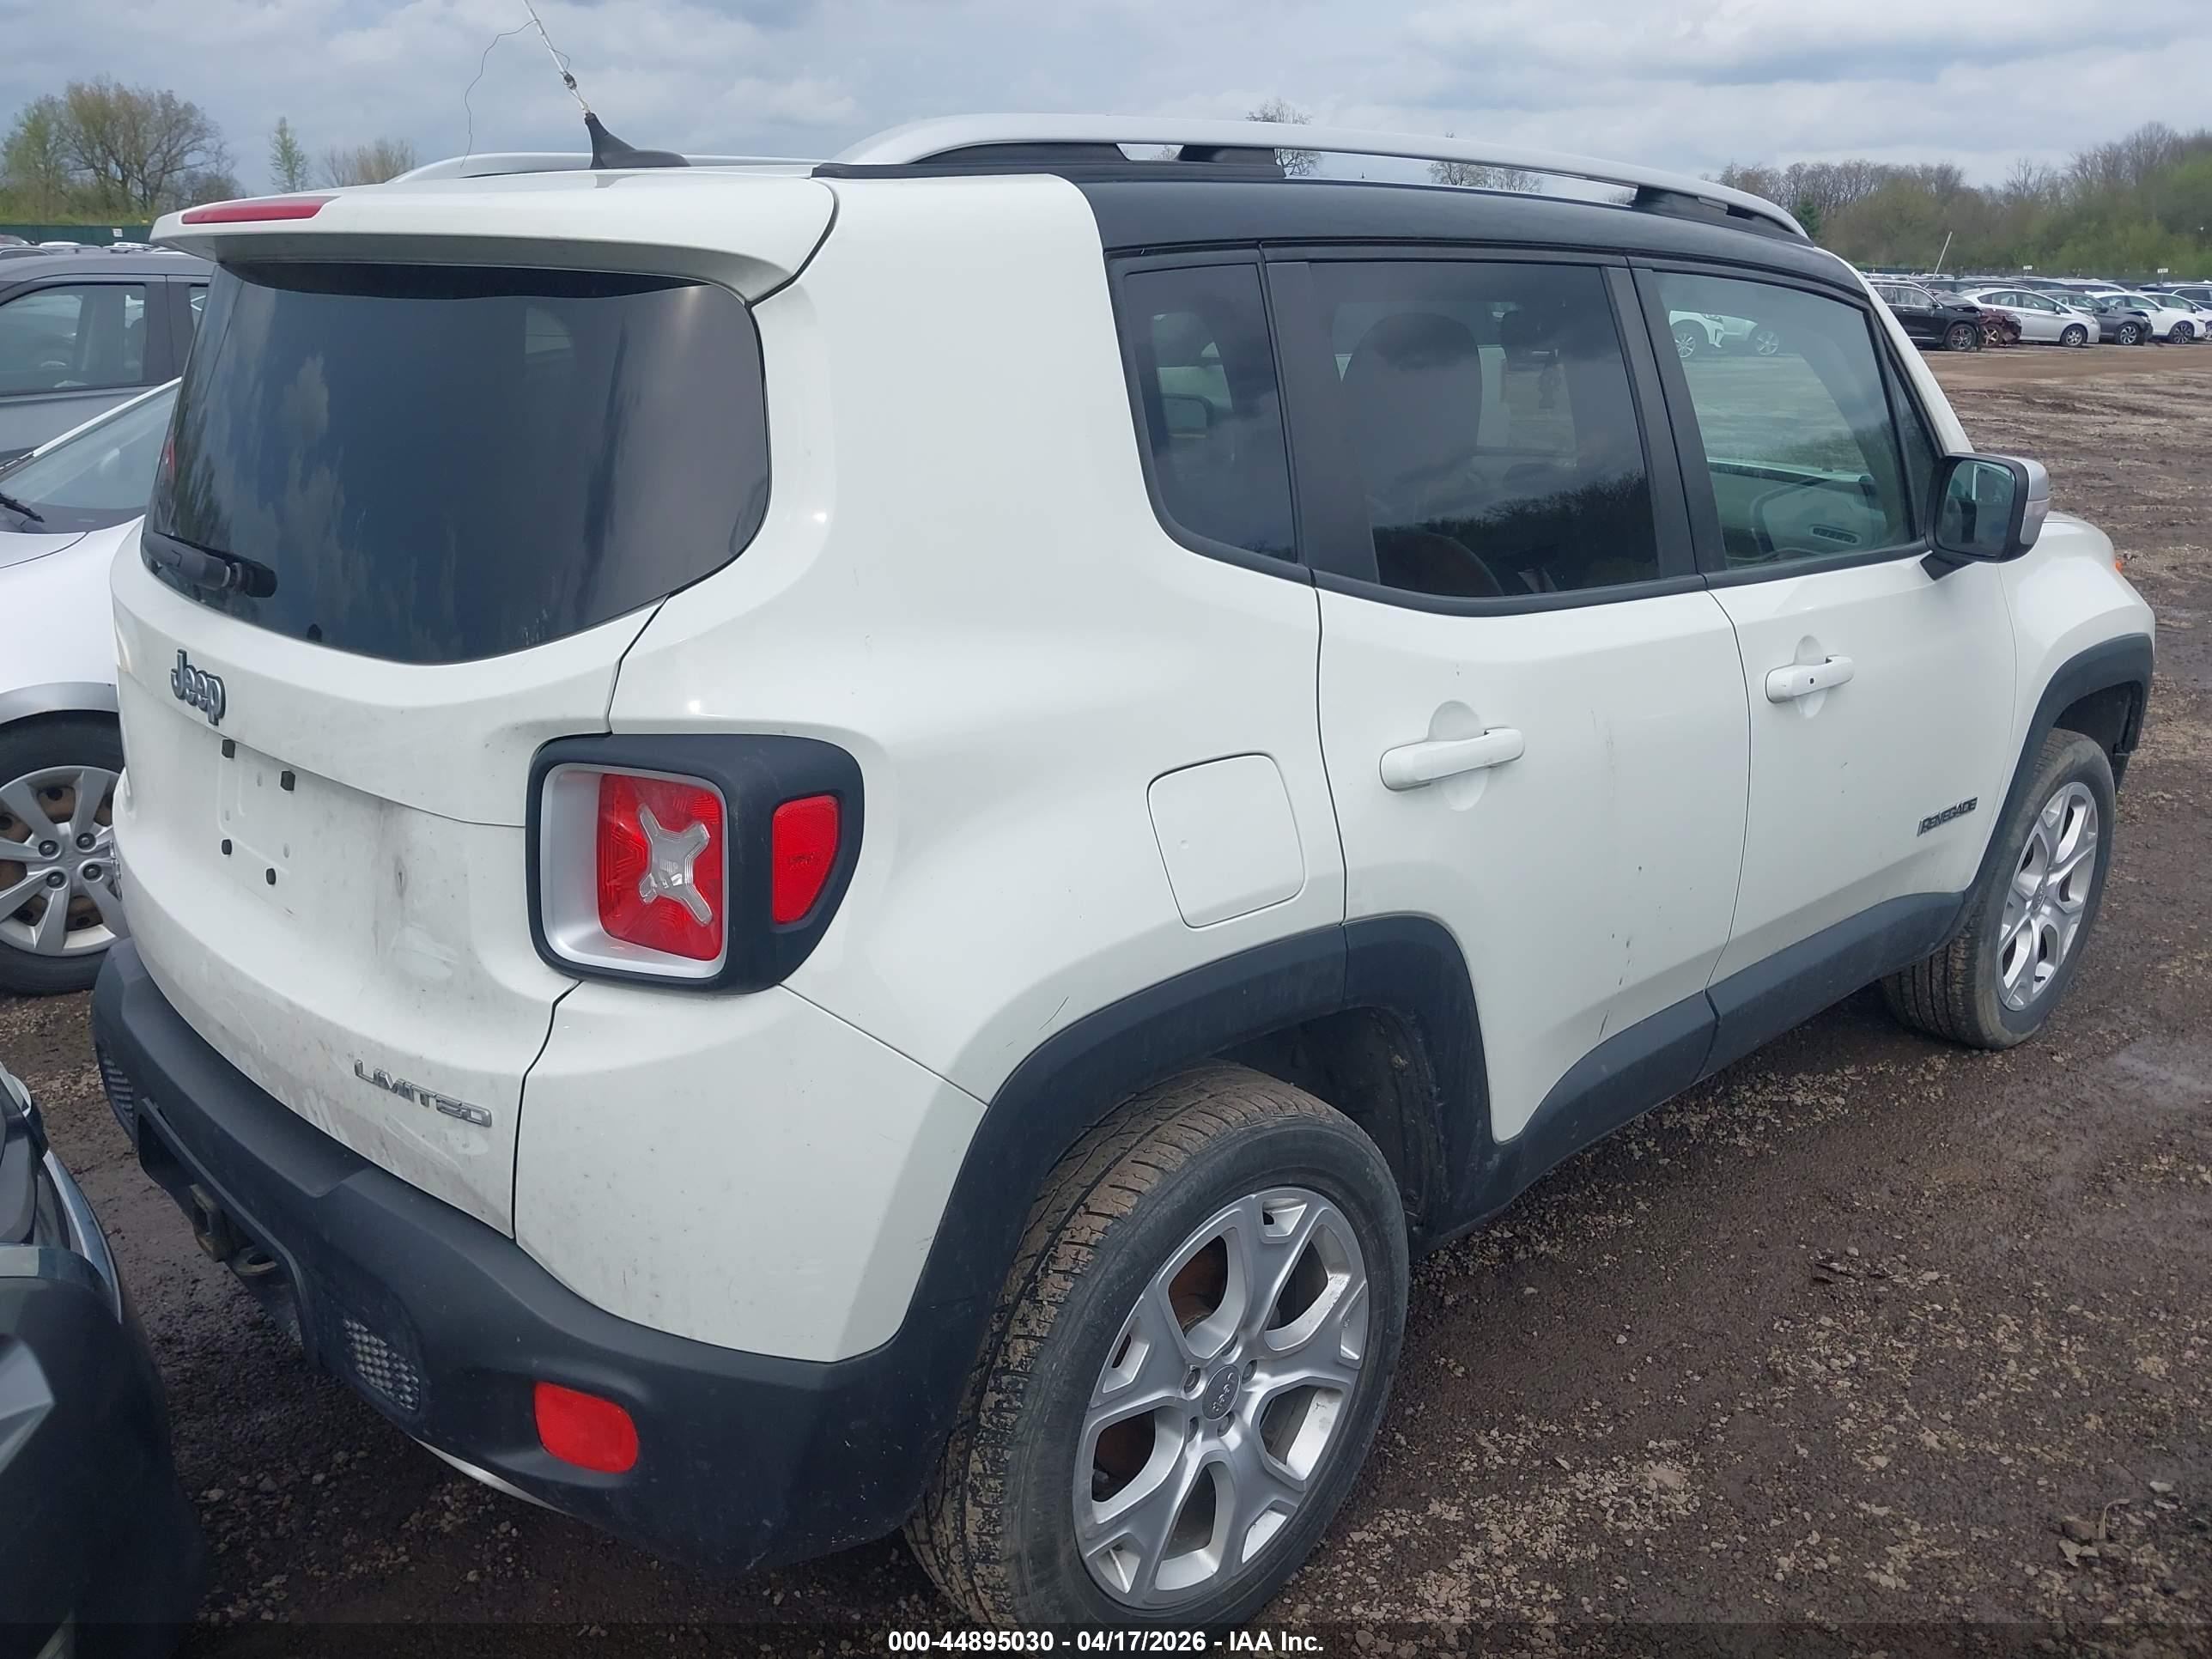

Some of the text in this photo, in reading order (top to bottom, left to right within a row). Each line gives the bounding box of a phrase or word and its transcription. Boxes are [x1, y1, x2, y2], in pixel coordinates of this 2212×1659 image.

[170, 648, 227, 726] Jeep
[1916, 796, 1978, 837] RENEGADE
[354, 1059, 493, 1127] LIMITED
